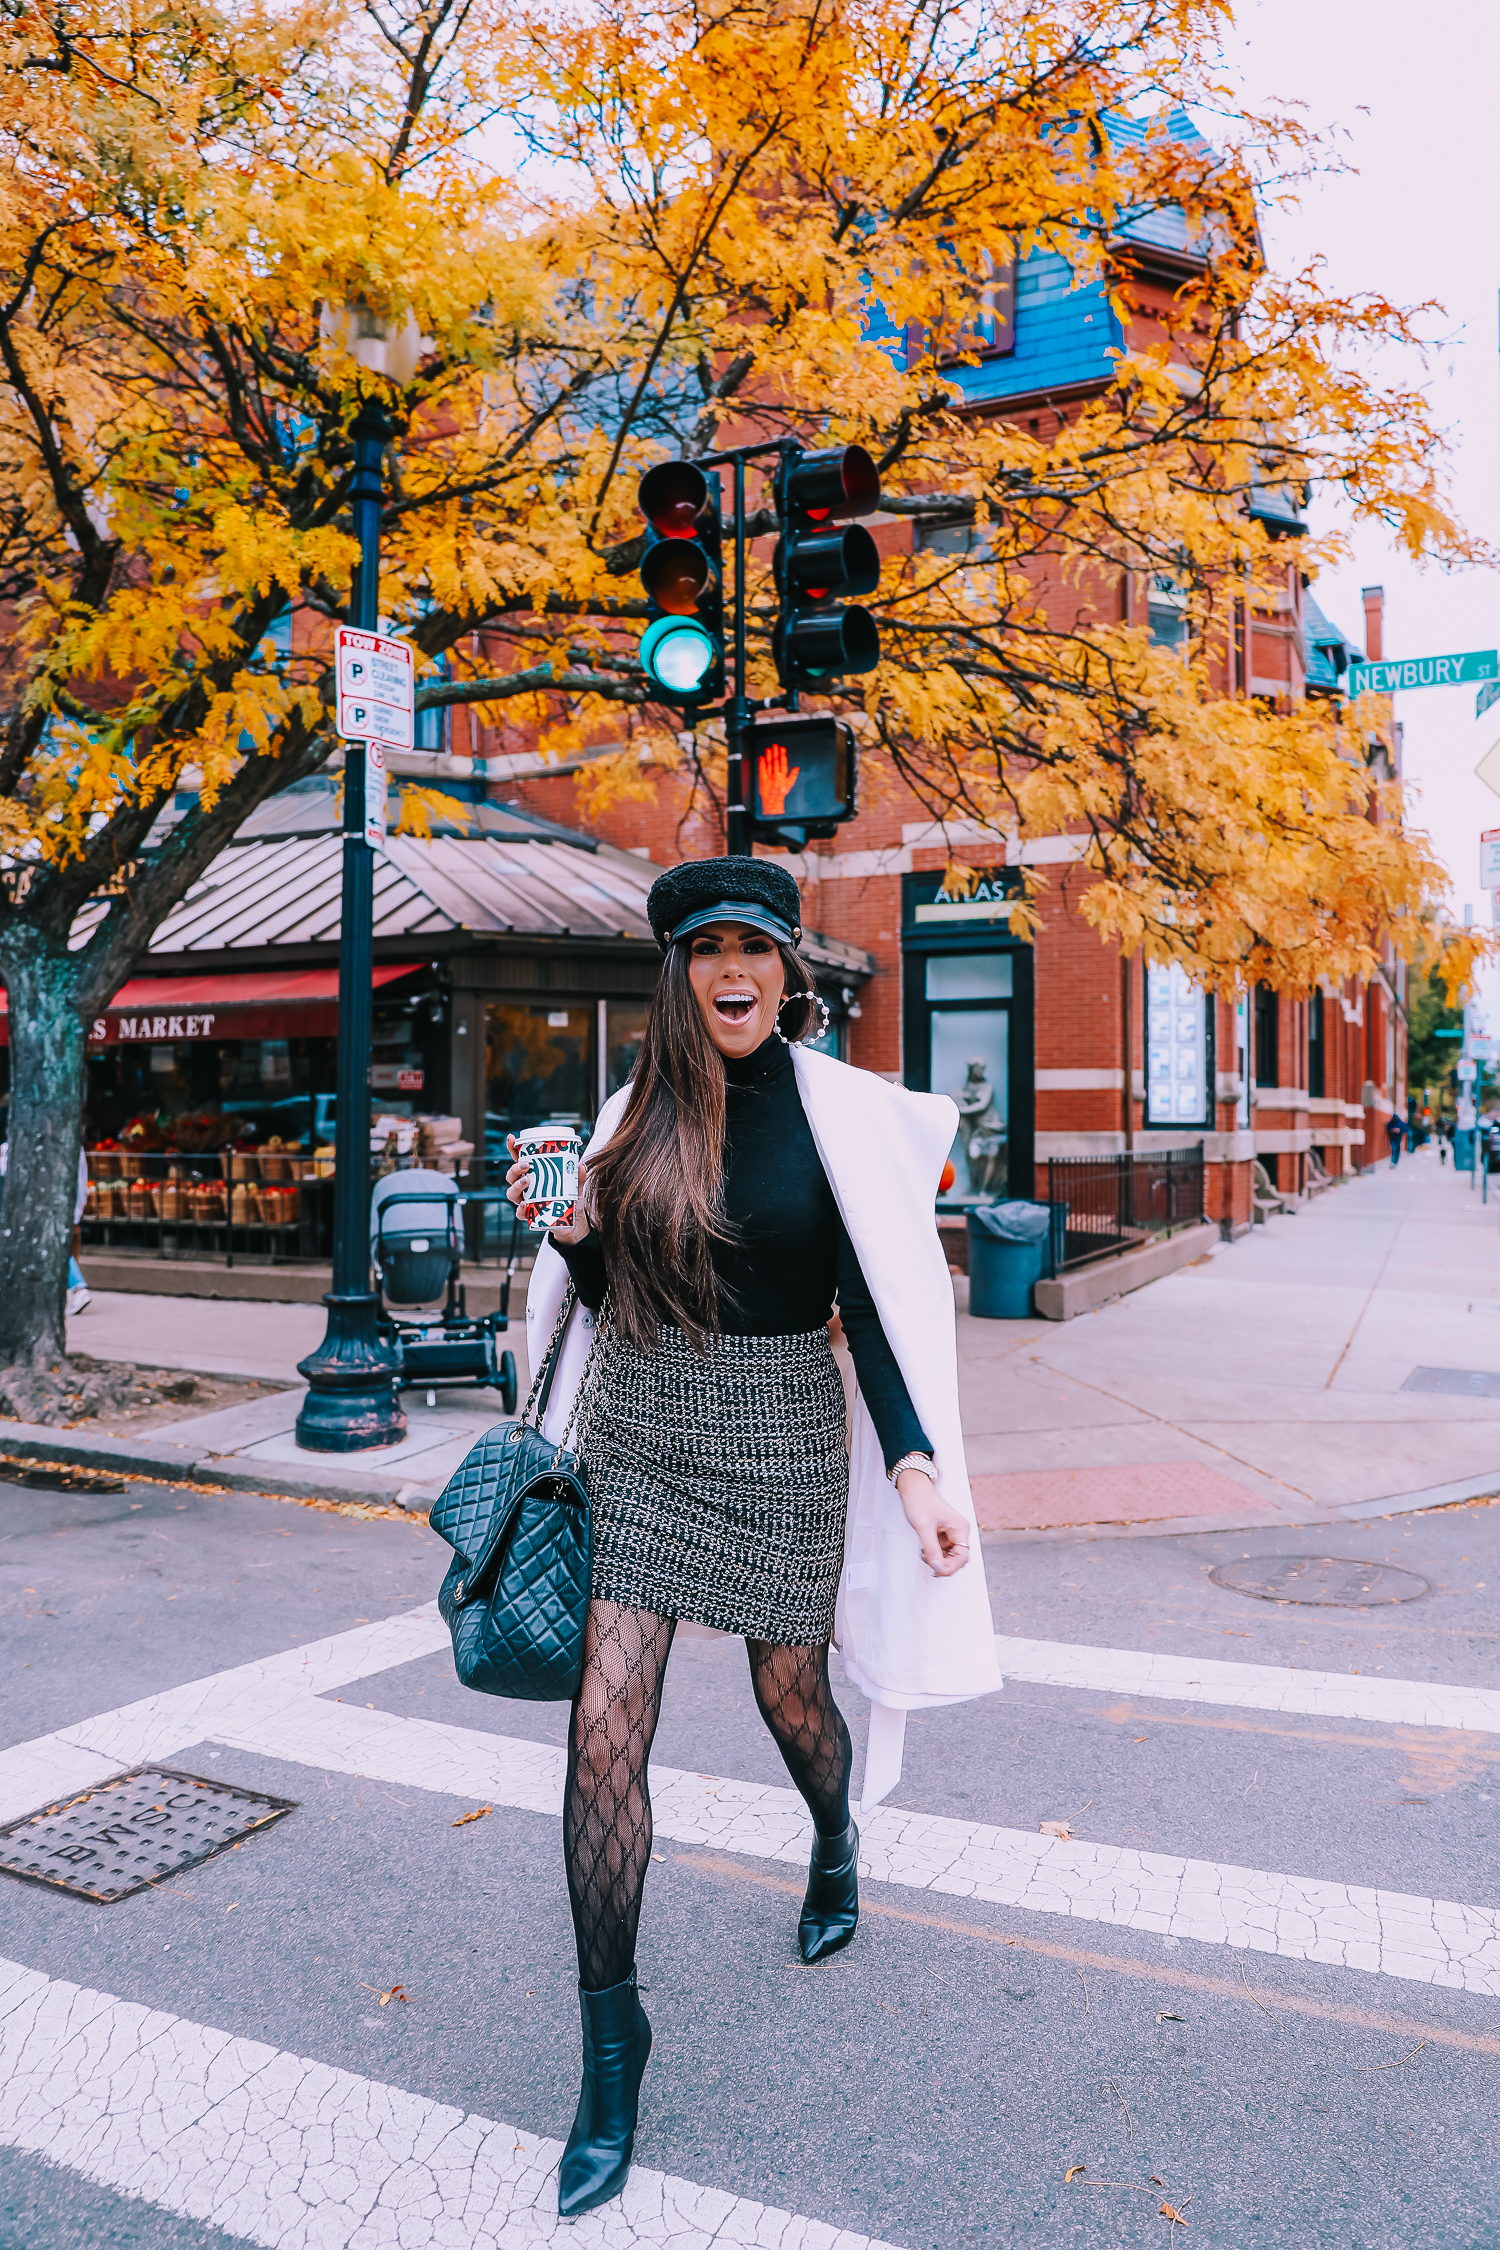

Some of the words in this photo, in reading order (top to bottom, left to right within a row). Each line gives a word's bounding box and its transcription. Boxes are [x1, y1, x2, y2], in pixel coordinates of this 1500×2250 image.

[343, 632, 376, 651] TOW
[378, 641, 408, 664] ZONE
[1355, 656, 1465, 691] NEWBURY
[933, 880, 1005, 904] ALAS
[117, 1013, 216, 1040] MARKET
[46, 1793, 207, 1866] BWSC
